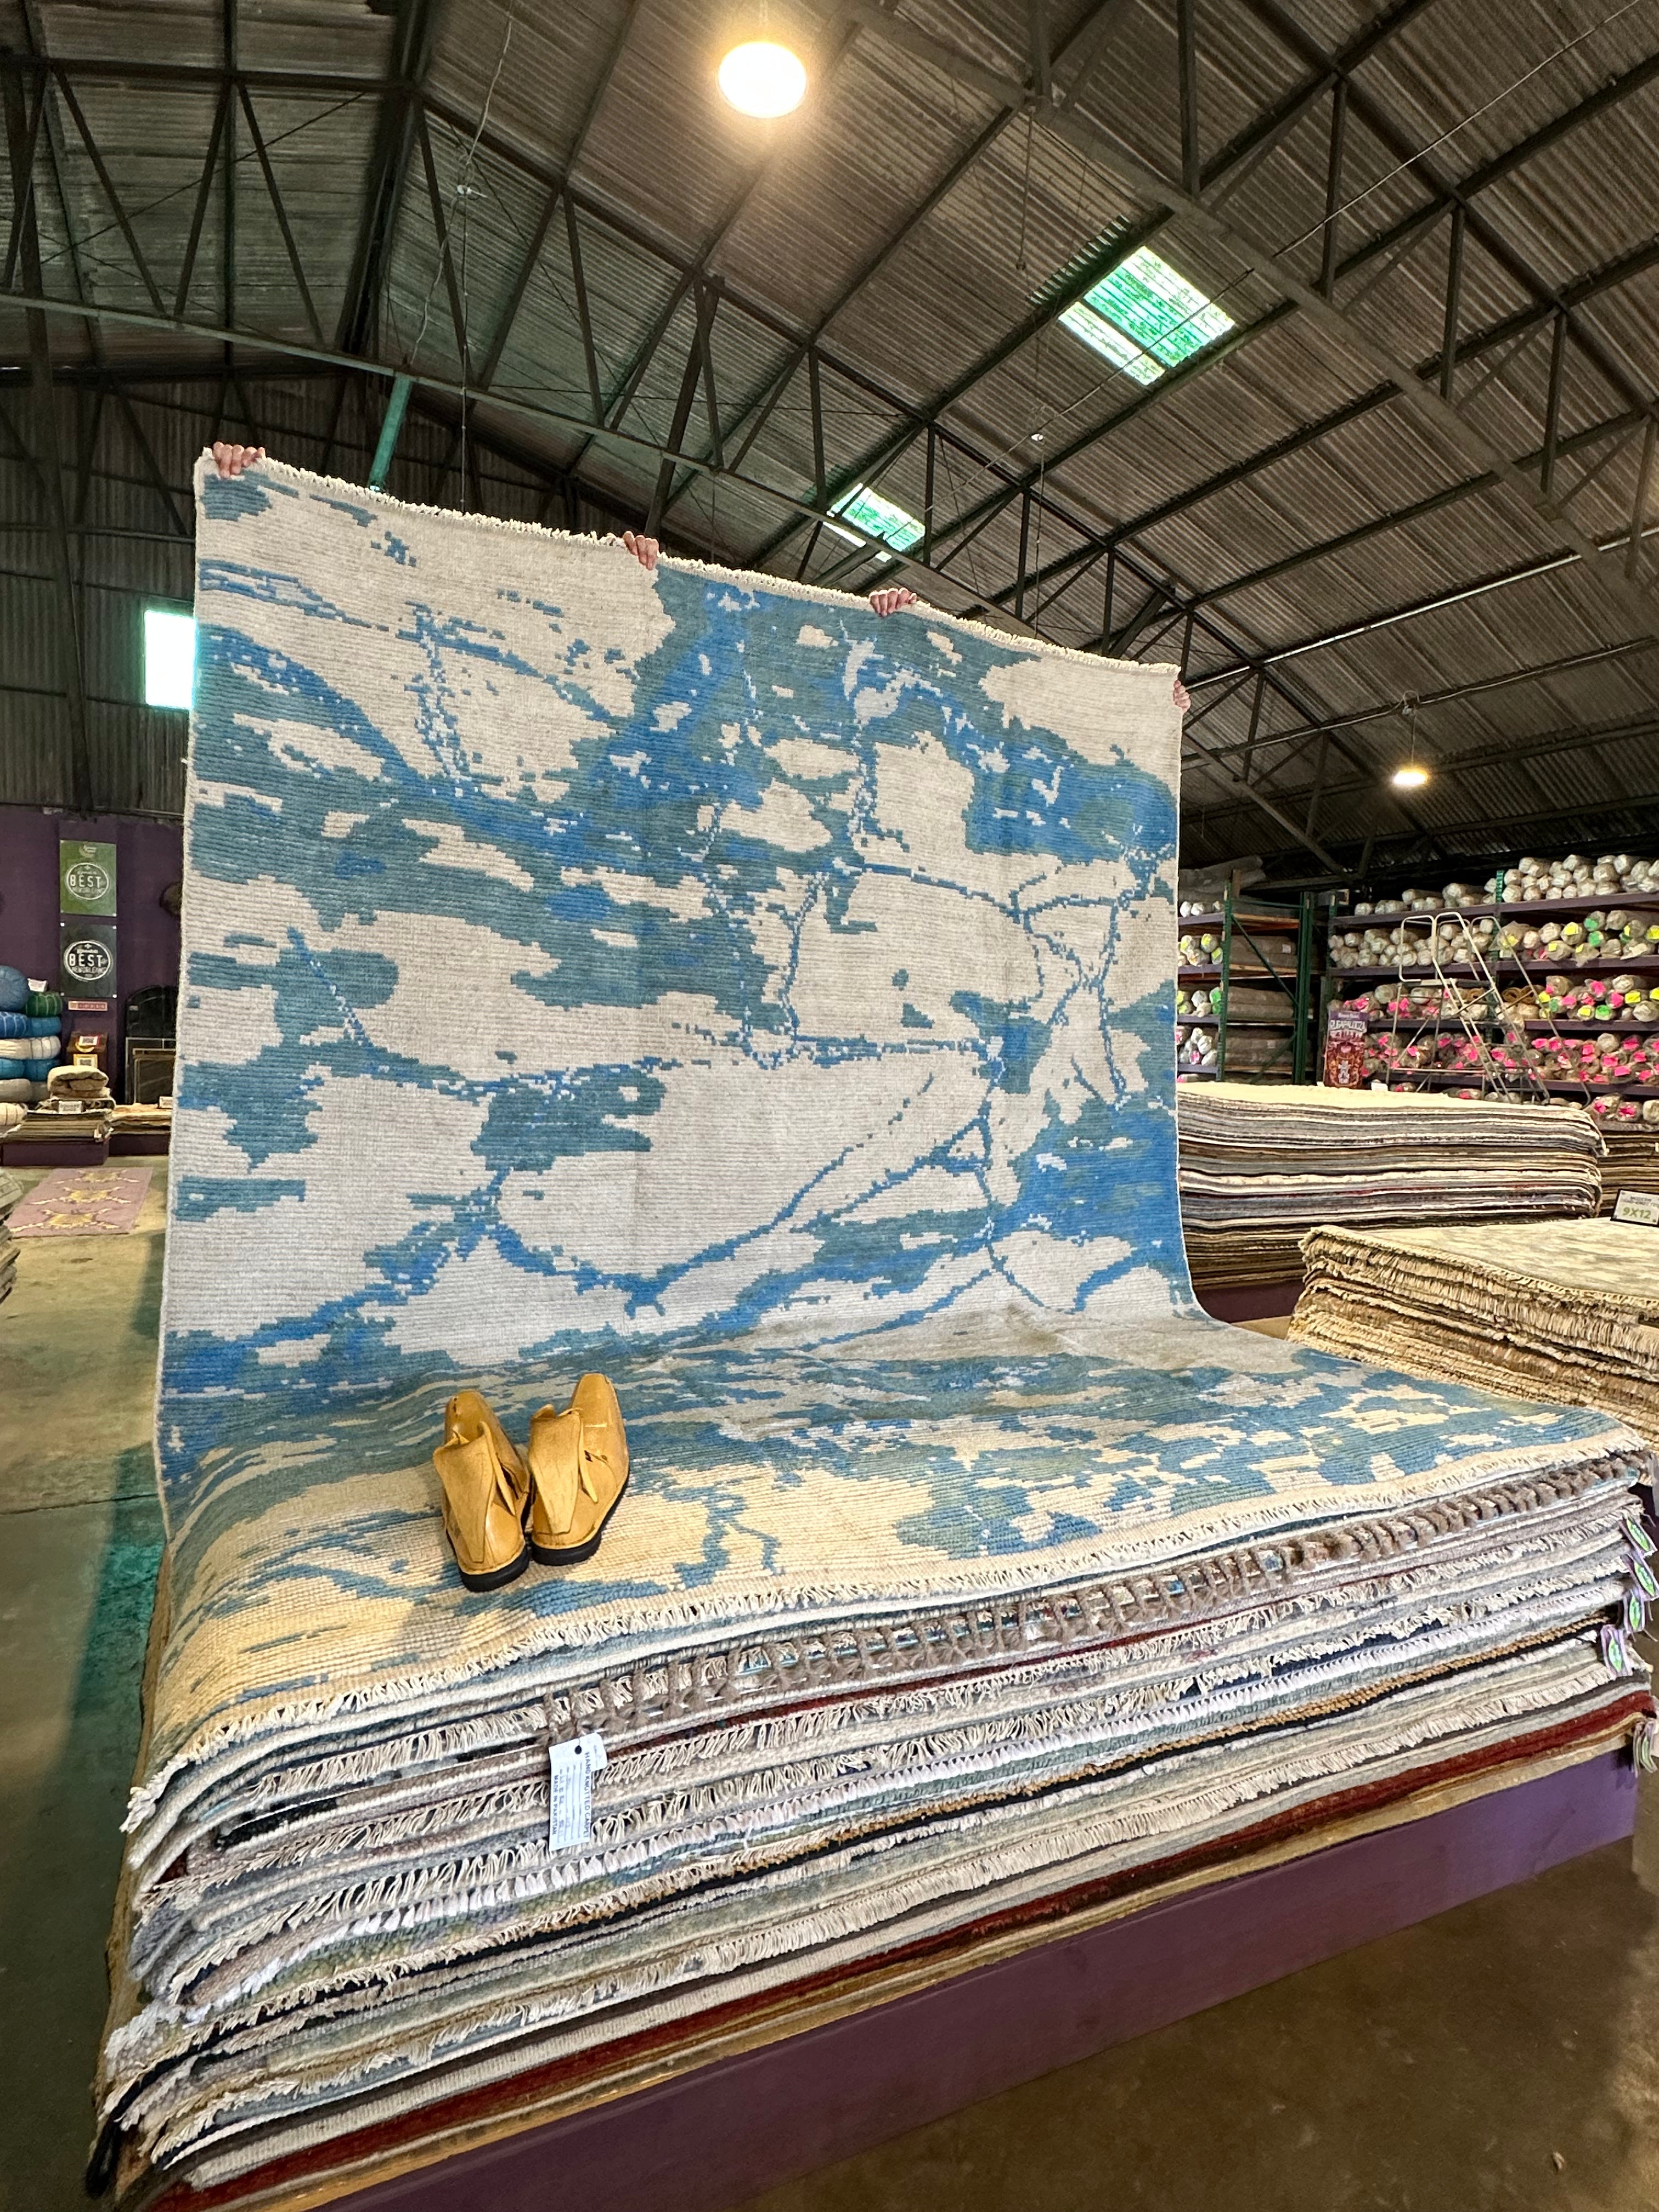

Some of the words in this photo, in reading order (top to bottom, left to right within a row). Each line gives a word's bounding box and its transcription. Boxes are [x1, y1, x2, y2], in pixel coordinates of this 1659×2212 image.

[70, 874, 101, 888] BEST
[69, 953, 103, 967] BEST
[1623, 1207, 1651, 1219] 9X12
